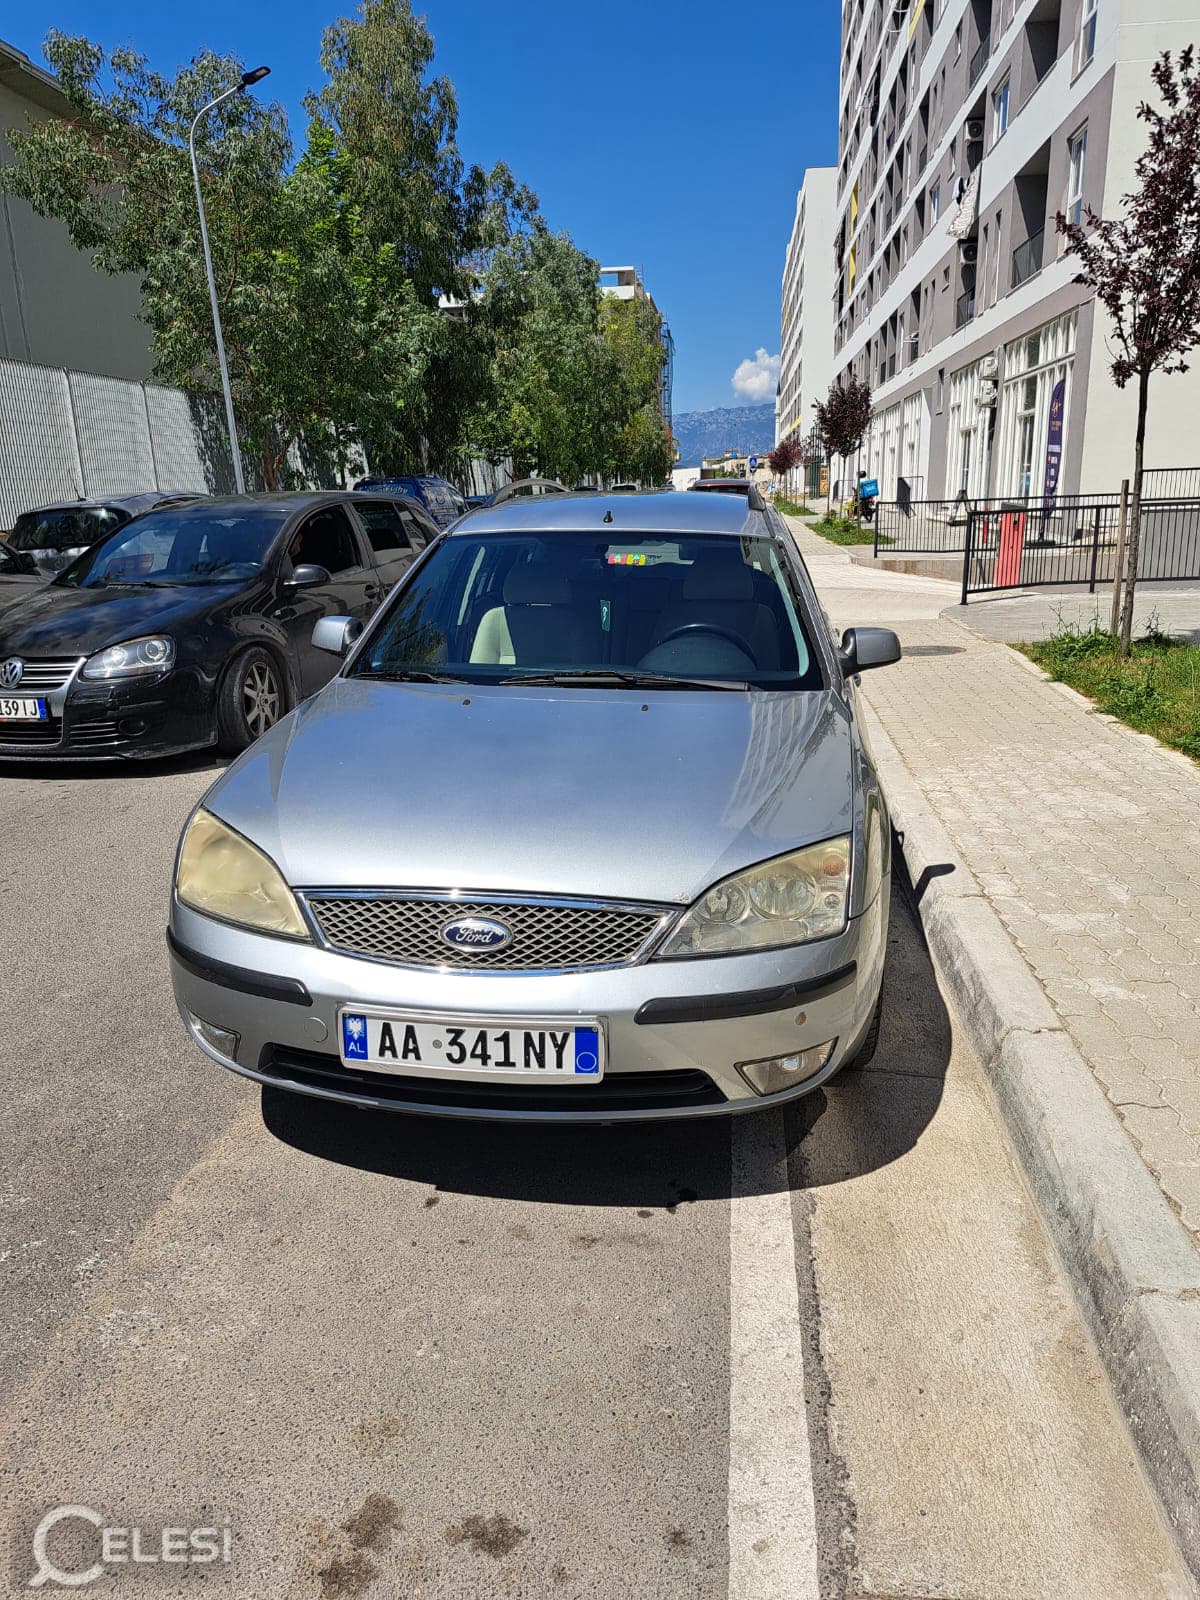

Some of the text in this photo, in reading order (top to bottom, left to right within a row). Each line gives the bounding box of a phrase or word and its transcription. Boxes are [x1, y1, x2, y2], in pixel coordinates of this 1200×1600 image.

[456, 927, 492, 943] Ford
[348, 1041, 365, 1053] AL
[379, 1022, 570, 1069] AA 341NY
